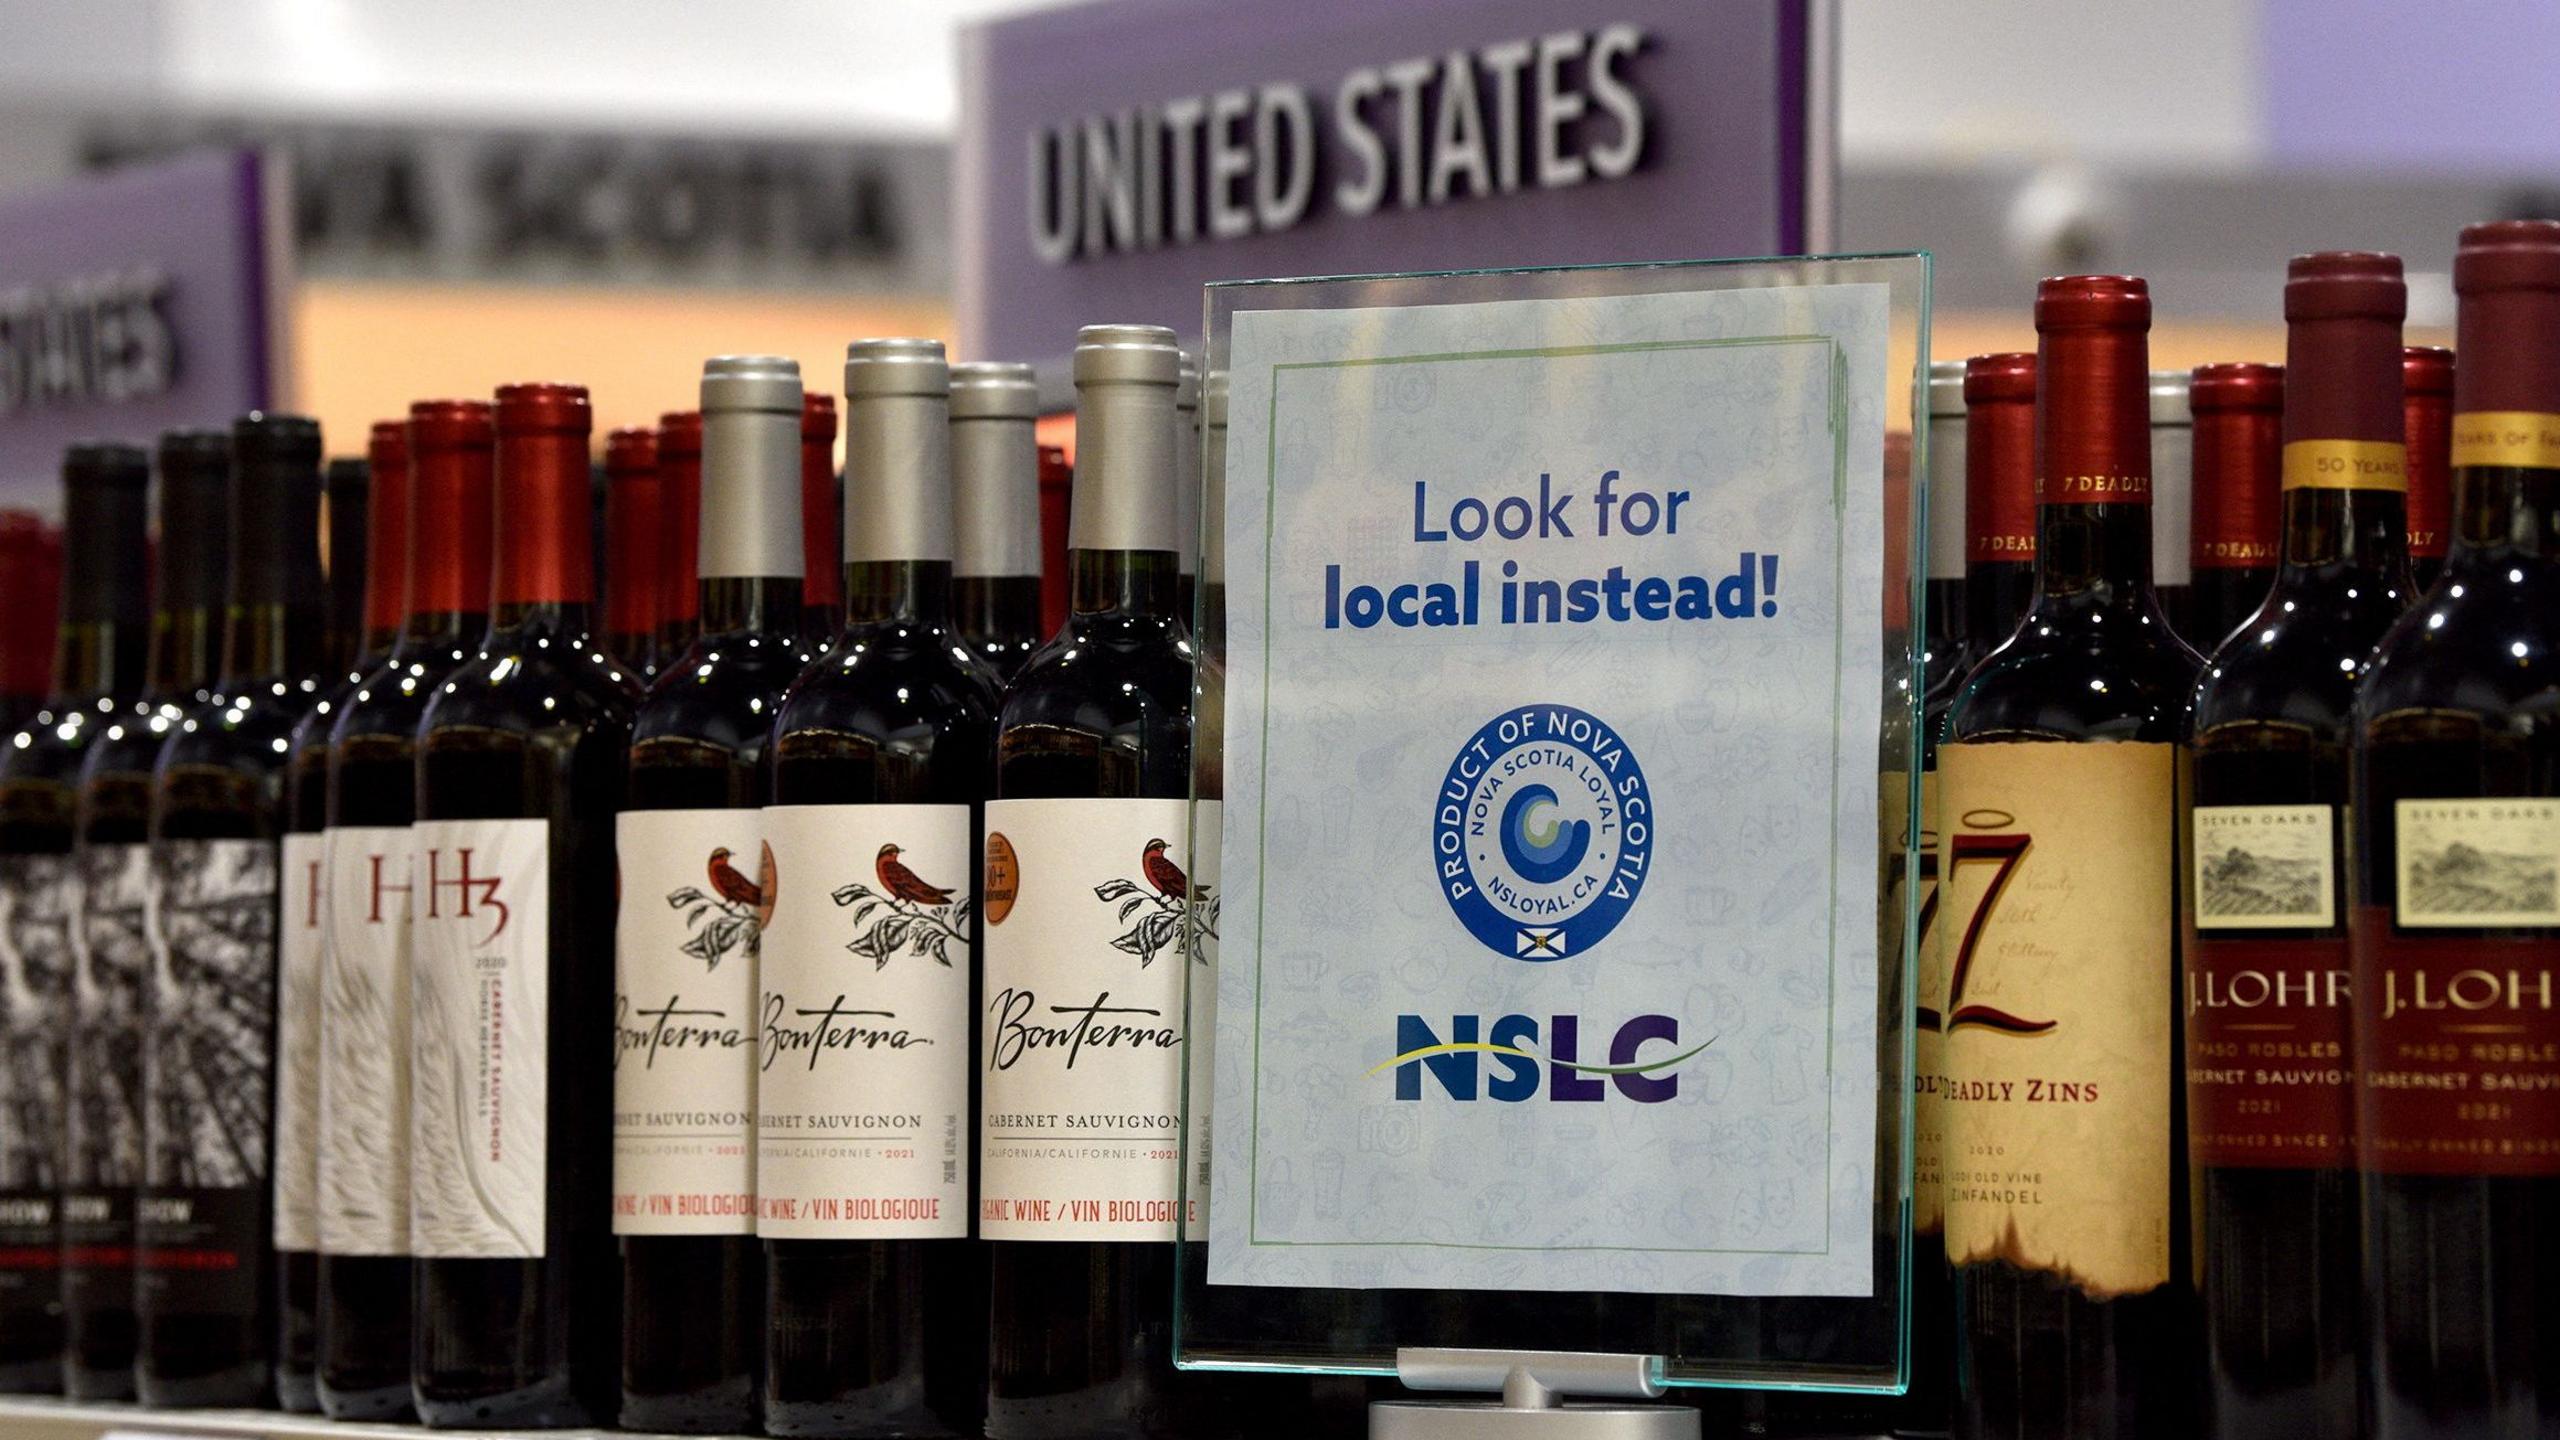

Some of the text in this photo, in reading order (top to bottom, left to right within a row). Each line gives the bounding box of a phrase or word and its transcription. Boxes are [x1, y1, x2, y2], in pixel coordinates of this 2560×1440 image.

[1028, 22, 1650, 266] UNITED STATES
[2317, 457, 2345, 473] 50
[2064, 477, 2073, 491] 7
[2079, 475, 2148, 492] DEADLY
[1414, 470, 1690, 542] Look for
[1325, 552, 1779, 629] local instead!
[1471, 749, 1615, 836] NOVA SCOTIA LOYAL
[1440, 711, 1647, 900] PRODUCT OF NOVA SCOTIA
[427, 847, 509, 950] H3
[1488, 874, 1598, 915] NSLOYAL.CA
[990, 987, 1182, 1072] Bonterra
[1395, 1013, 1680, 1104] NSLC
[2026, 1079, 2099, 1103] ZINS
[646, 1111, 751, 1127] SAUVIGNON
[808, 1114, 922, 1130] SAUVIGNON
[988, 1113, 1058, 1129] CABERNET
[885, 1149, 915, 1159] 2021
[1150, 1150, 1178, 1160] 2021
[1975, 1172, 1999, 1184] OLD
[2007, 1172, 2042, 1185] VINE
[649, 1194, 673, 1216] VIN
[1951, 1187, 2043, 1205] ZINFANDEL
[770, 1198, 797, 1220] WINE
[812, 1198, 838, 1221] VIN
[844, 1198, 940, 1221] BIOLOGIQUE
[1014, 1199, 1051, 1222] WINE
[1071, 1200, 1100, 1222] VIN
[1108, 1200, 1196, 1223] BIOLOGIE
